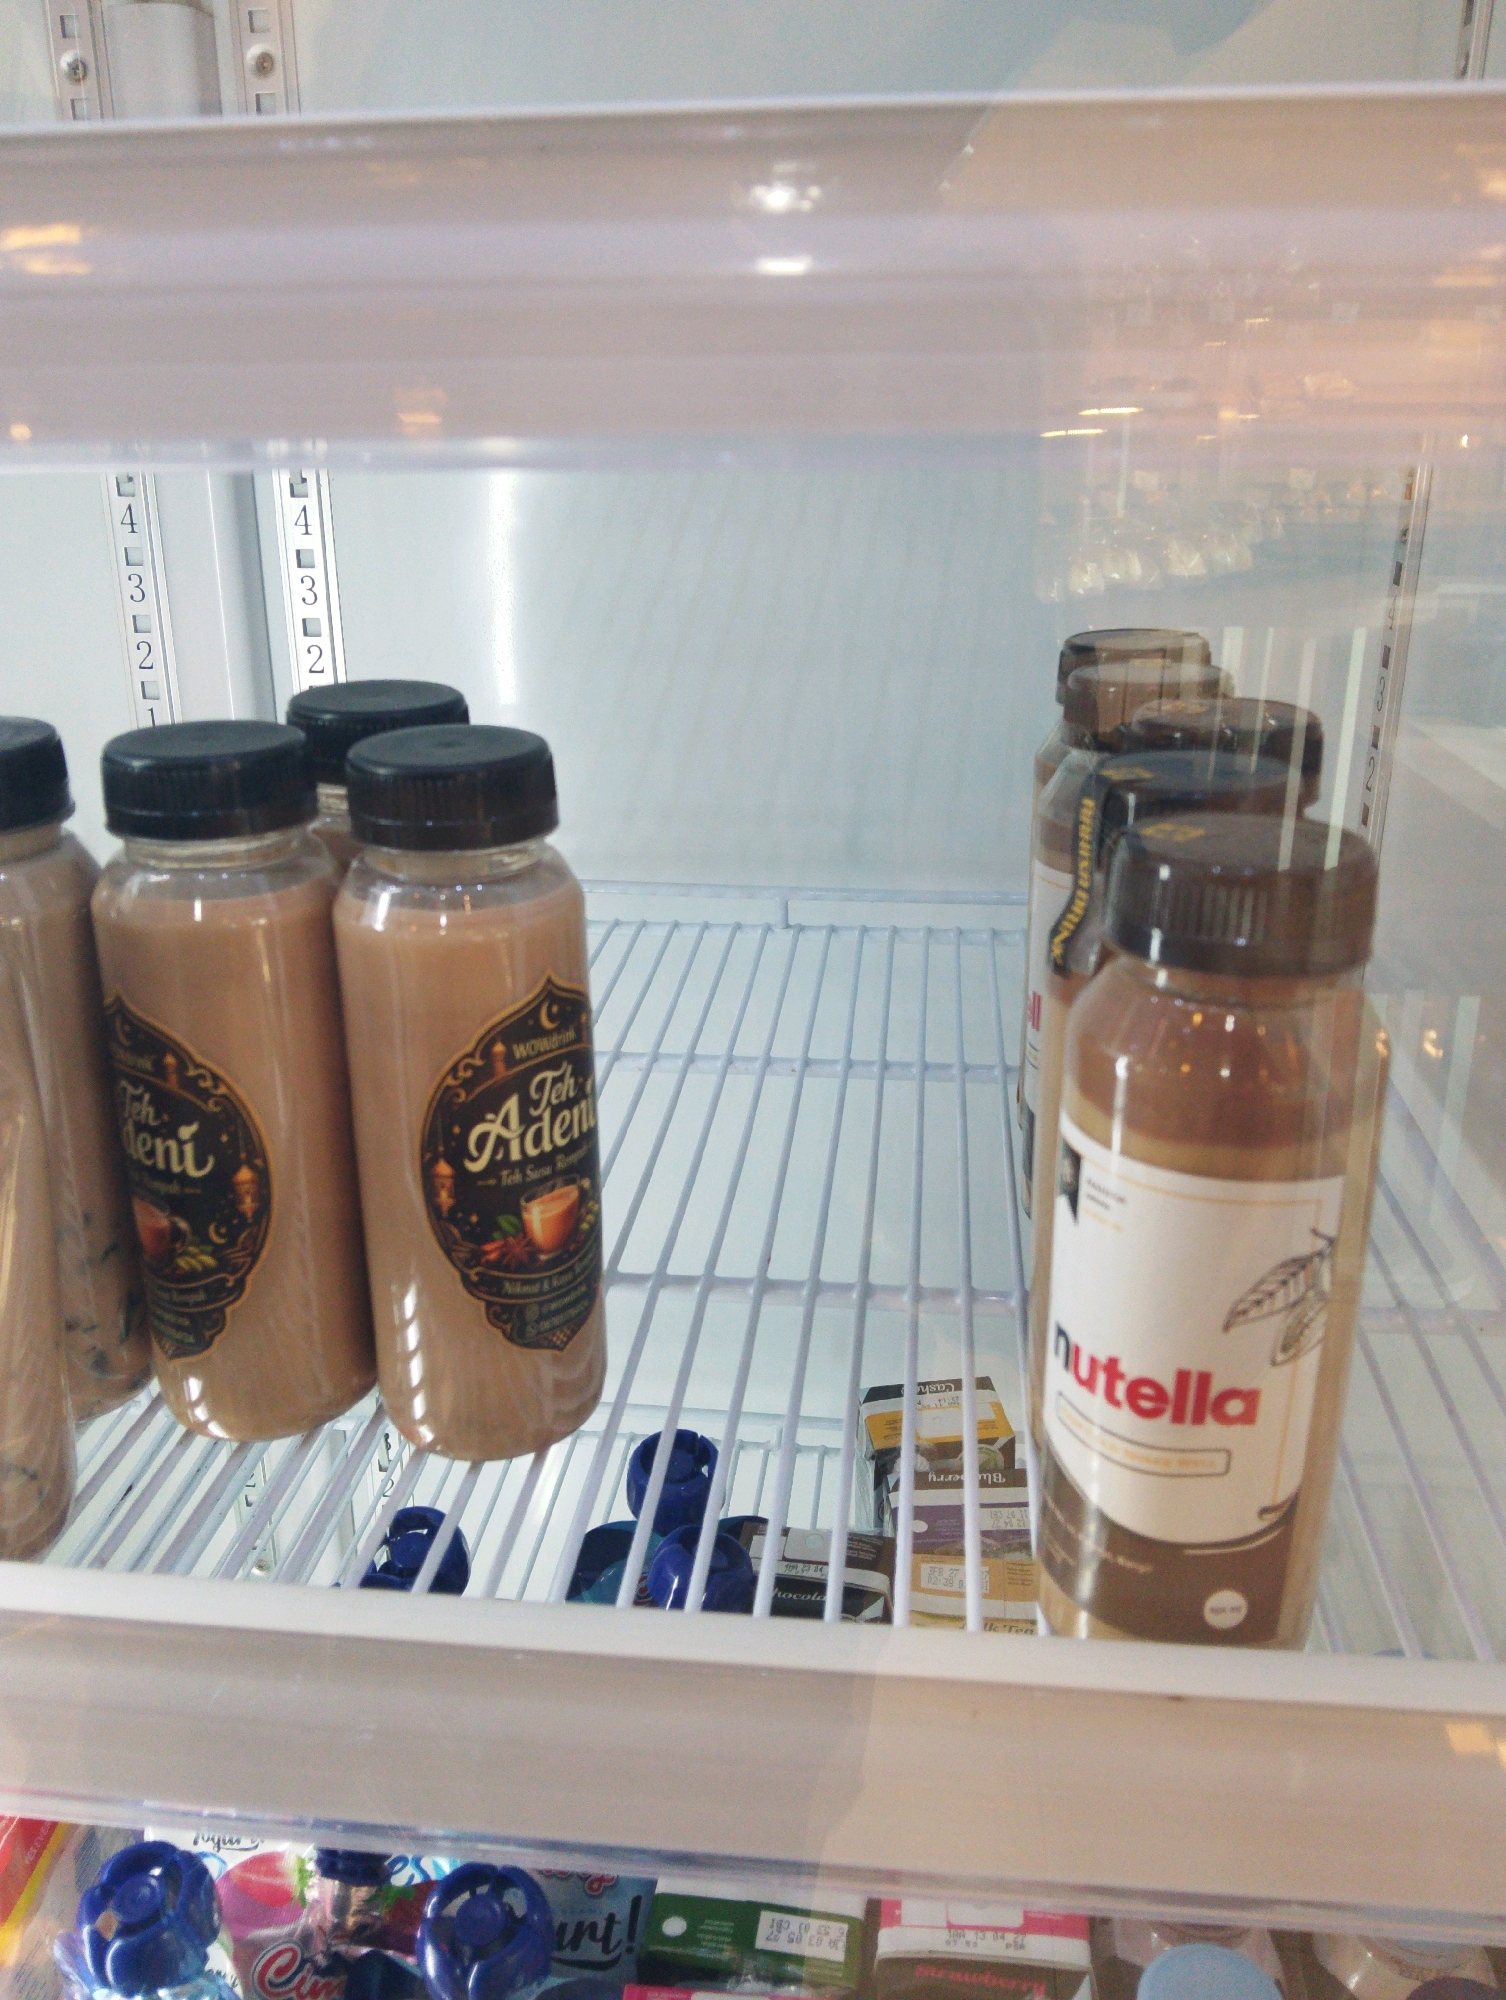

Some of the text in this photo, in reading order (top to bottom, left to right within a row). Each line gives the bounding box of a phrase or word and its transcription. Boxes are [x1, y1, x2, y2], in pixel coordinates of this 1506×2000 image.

[120, 503, 138, 534] 4
[294, 504, 313, 536] 4
[128, 573, 146, 603] 3
[300, 575, 318, 606] 3
[136, 641, 154, 670] 2
[306, 644, 325, 674] 2
[1376, 675, 1386, 712] 3
[1365, 756, 1375, 792] 2
[120, 1079, 160, 1126] Teh
[529, 1060, 580, 1117] Teh
[123, 1117, 215, 1178] deni
[1053, 1321, 1261, 1426] nutella
[928, 1472, 1006, 1485] Bluerry
